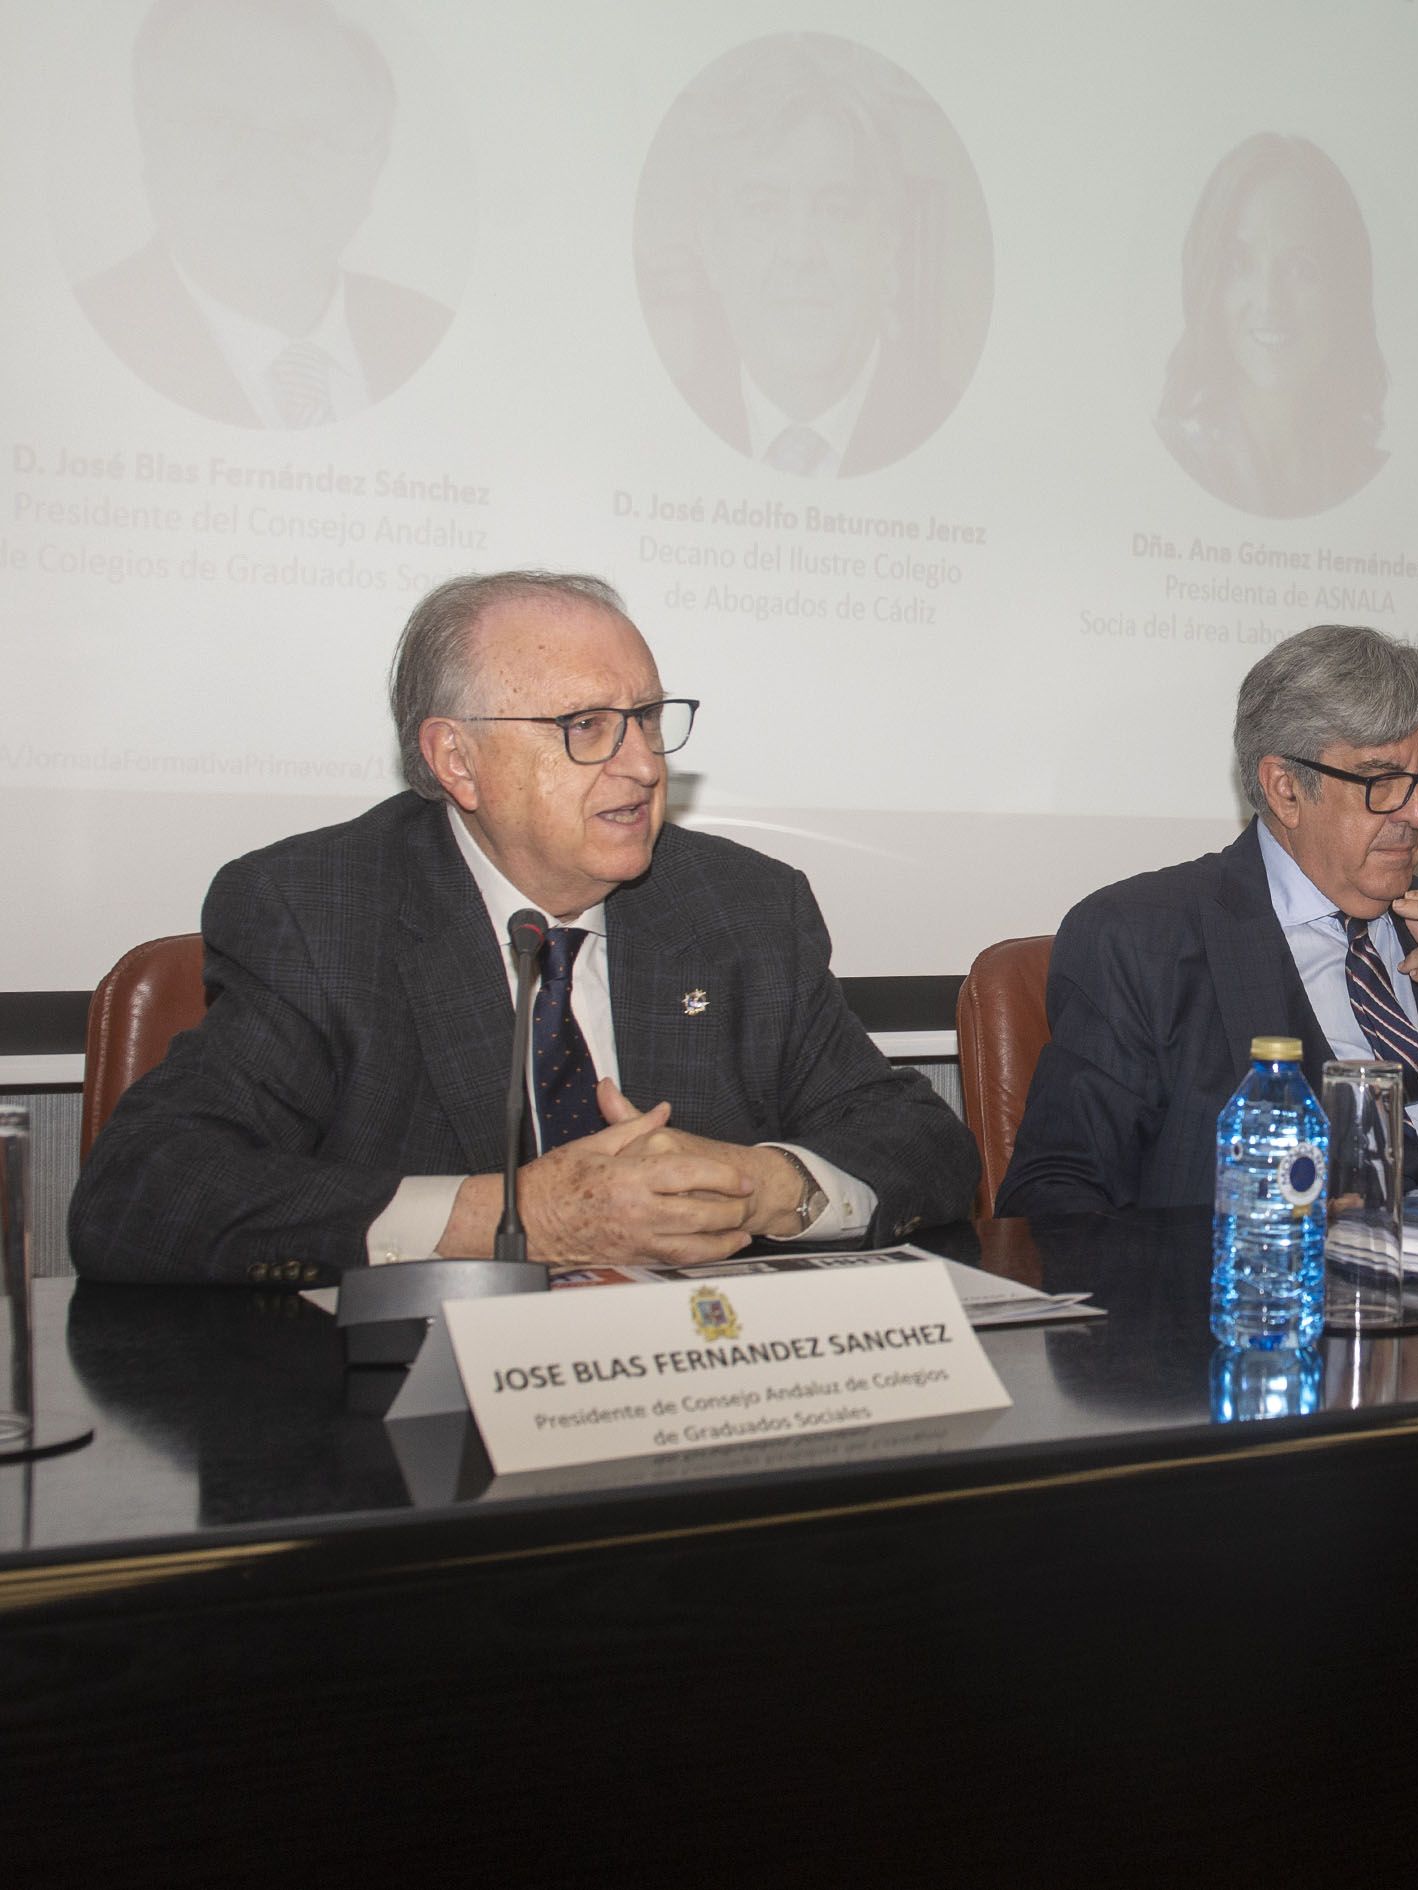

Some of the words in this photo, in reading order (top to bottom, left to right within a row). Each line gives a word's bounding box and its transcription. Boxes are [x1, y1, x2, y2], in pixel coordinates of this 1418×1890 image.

[13, 444, 45, 474] D.
[55, 448, 125, 480] José
[135, 452, 199, 485] Blas
[209, 458, 366, 495] Fernández
[374, 470, 490, 506] Sánchez
[14, 492, 183, 532] Presidente
[192, 500, 239, 534] del
[249, 507, 367, 548] Consejo
[374, 515, 488, 551] Andaluz
[612, 490, 640, 518] D.
[647, 494, 704, 523] José
[712, 499, 798, 530] Adolfo
[805, 506, 920, 541] Baturone
[925, 517, 988, 546] Jerez
[38, 544, 170, 584] Colegios
[179, 551, 217, 581] de
[226, 553, 387, 591] Graduados
[638, 536, 735, 570] Decano
[743, 542, 782, 573] del
[790, 547, 866, 579] Ilustre
[873, 553, 963, 590] Colegio
[1132, 532, 1183, 560] Dña.
[1189, 538, 1232, 565] Ana
[1238, 541, 1310, 571] Gómez
[664, 582, 696, 609] de
[703, 585, 828, 623] Abogados
[835, 593, 866, 621] de
[873, 595, 938, 626] Cádiz
[1165, 574, 1278, 608] Presidenta
[1283, 582, 1310, 608] de
[1314, 586, 1397, 615] ASNALA
[1079, 609, 1136, 639] Socia
[1143, 614, 1177, 641] del
[1183, 616, 1231, 645] área
[494, 1364, 565, 1393] JOSE
[572, 1356, 647, 1385] BLAS
[653, 1337, 824, 1375] FERNANDEZ
[828, 1323, 952, 1354] SANCHEZ
[534, 1403, 648, 1430] Presidente
[651, 1399, 679, 1417] de
[681, 1390, 761, 1413] Consejo
[766, 1380, 841, 1401] Andaluz
[845, 1375, 869, 1393] de
[872, 1367, 950, 1390] Colegios
[653, 1427, 679, 1446] de
[683, 1414, 791, 1440] Graduados
[793, 1403, 873, 1427] Sociales
